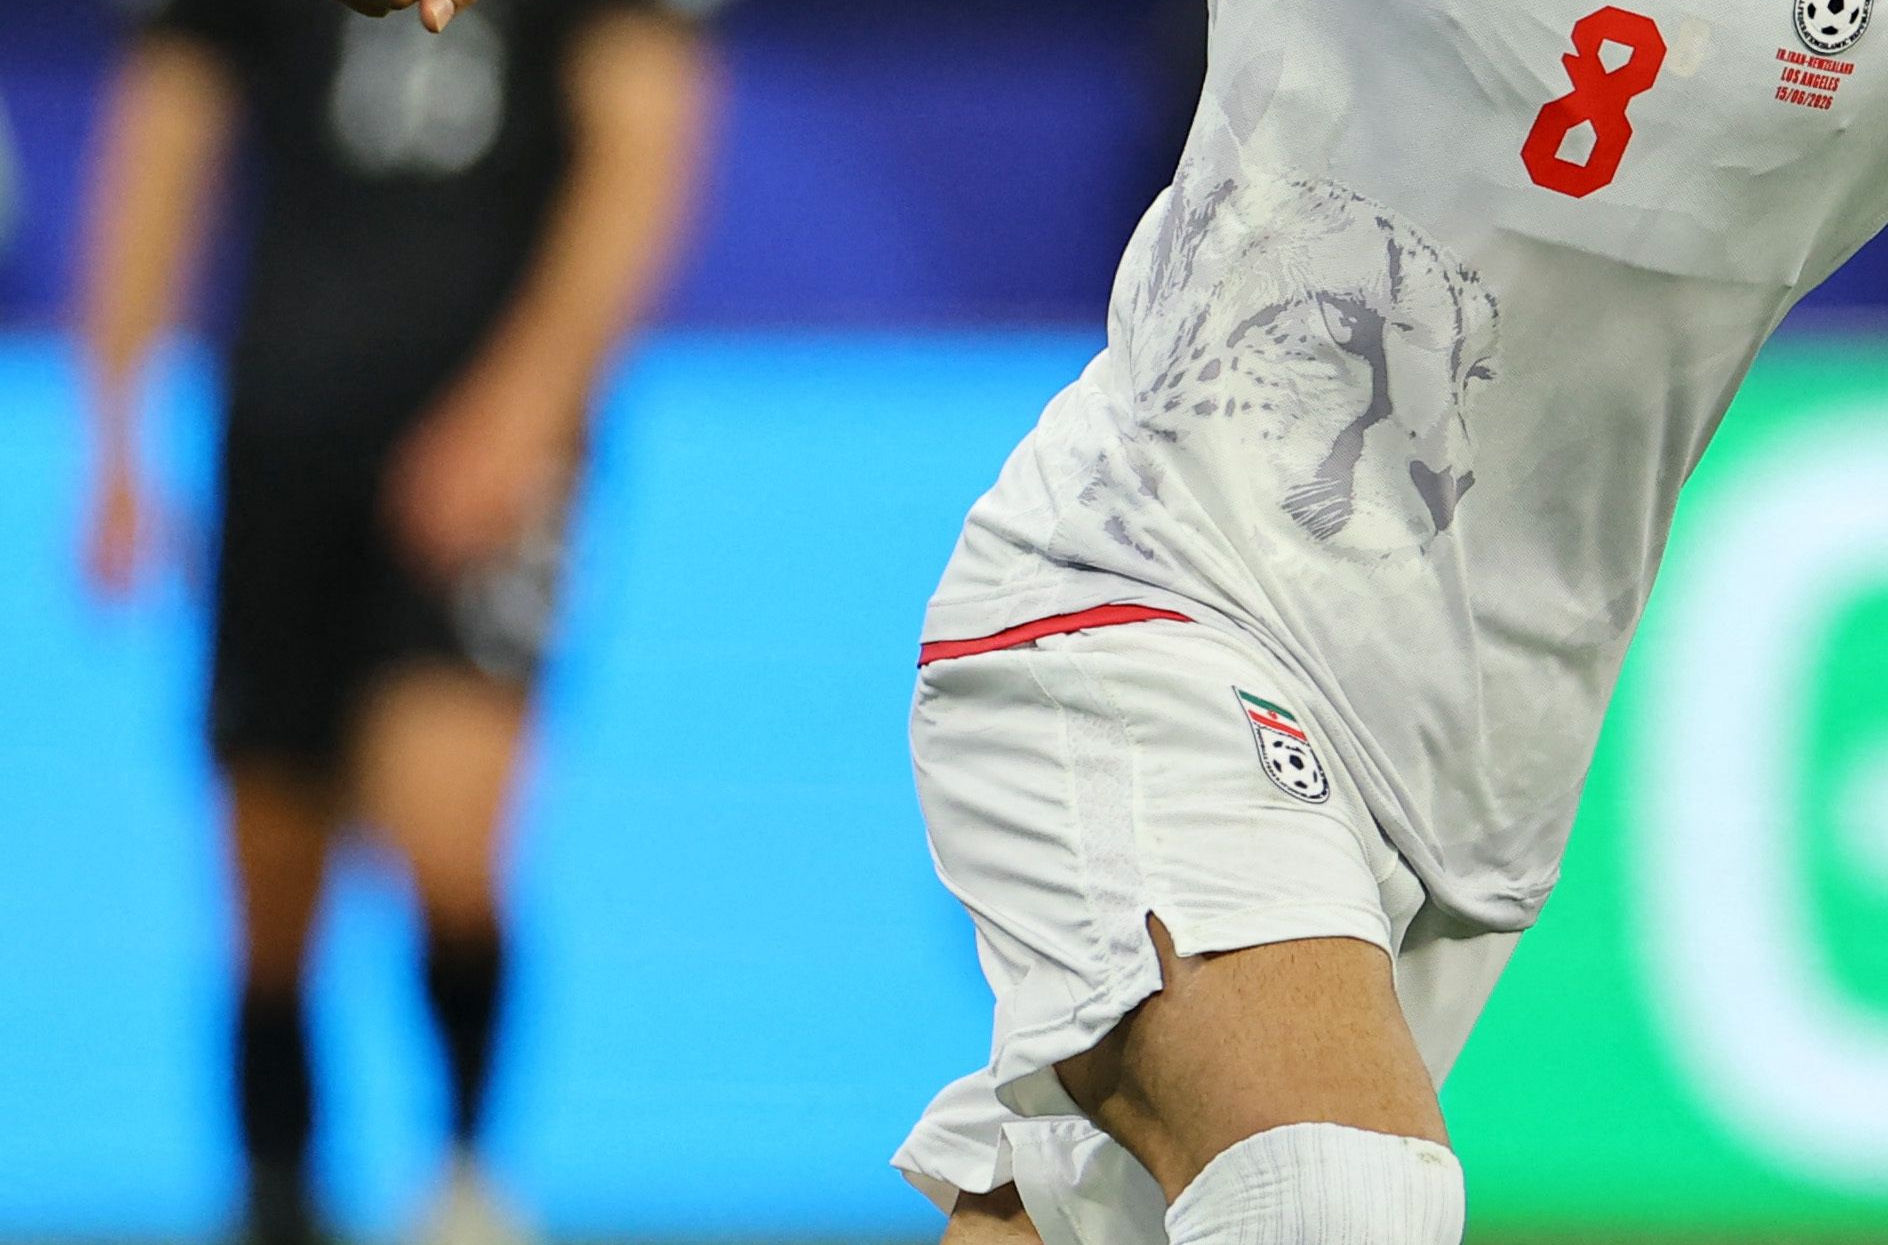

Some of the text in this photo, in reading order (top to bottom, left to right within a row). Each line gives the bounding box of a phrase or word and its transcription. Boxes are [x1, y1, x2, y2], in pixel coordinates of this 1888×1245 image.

[1781, 67, 1840, 92] LOS ANGELES
[1520, 6, 1667, 198] 8
[1775, 86, 1833, 110] 15/06/2026
